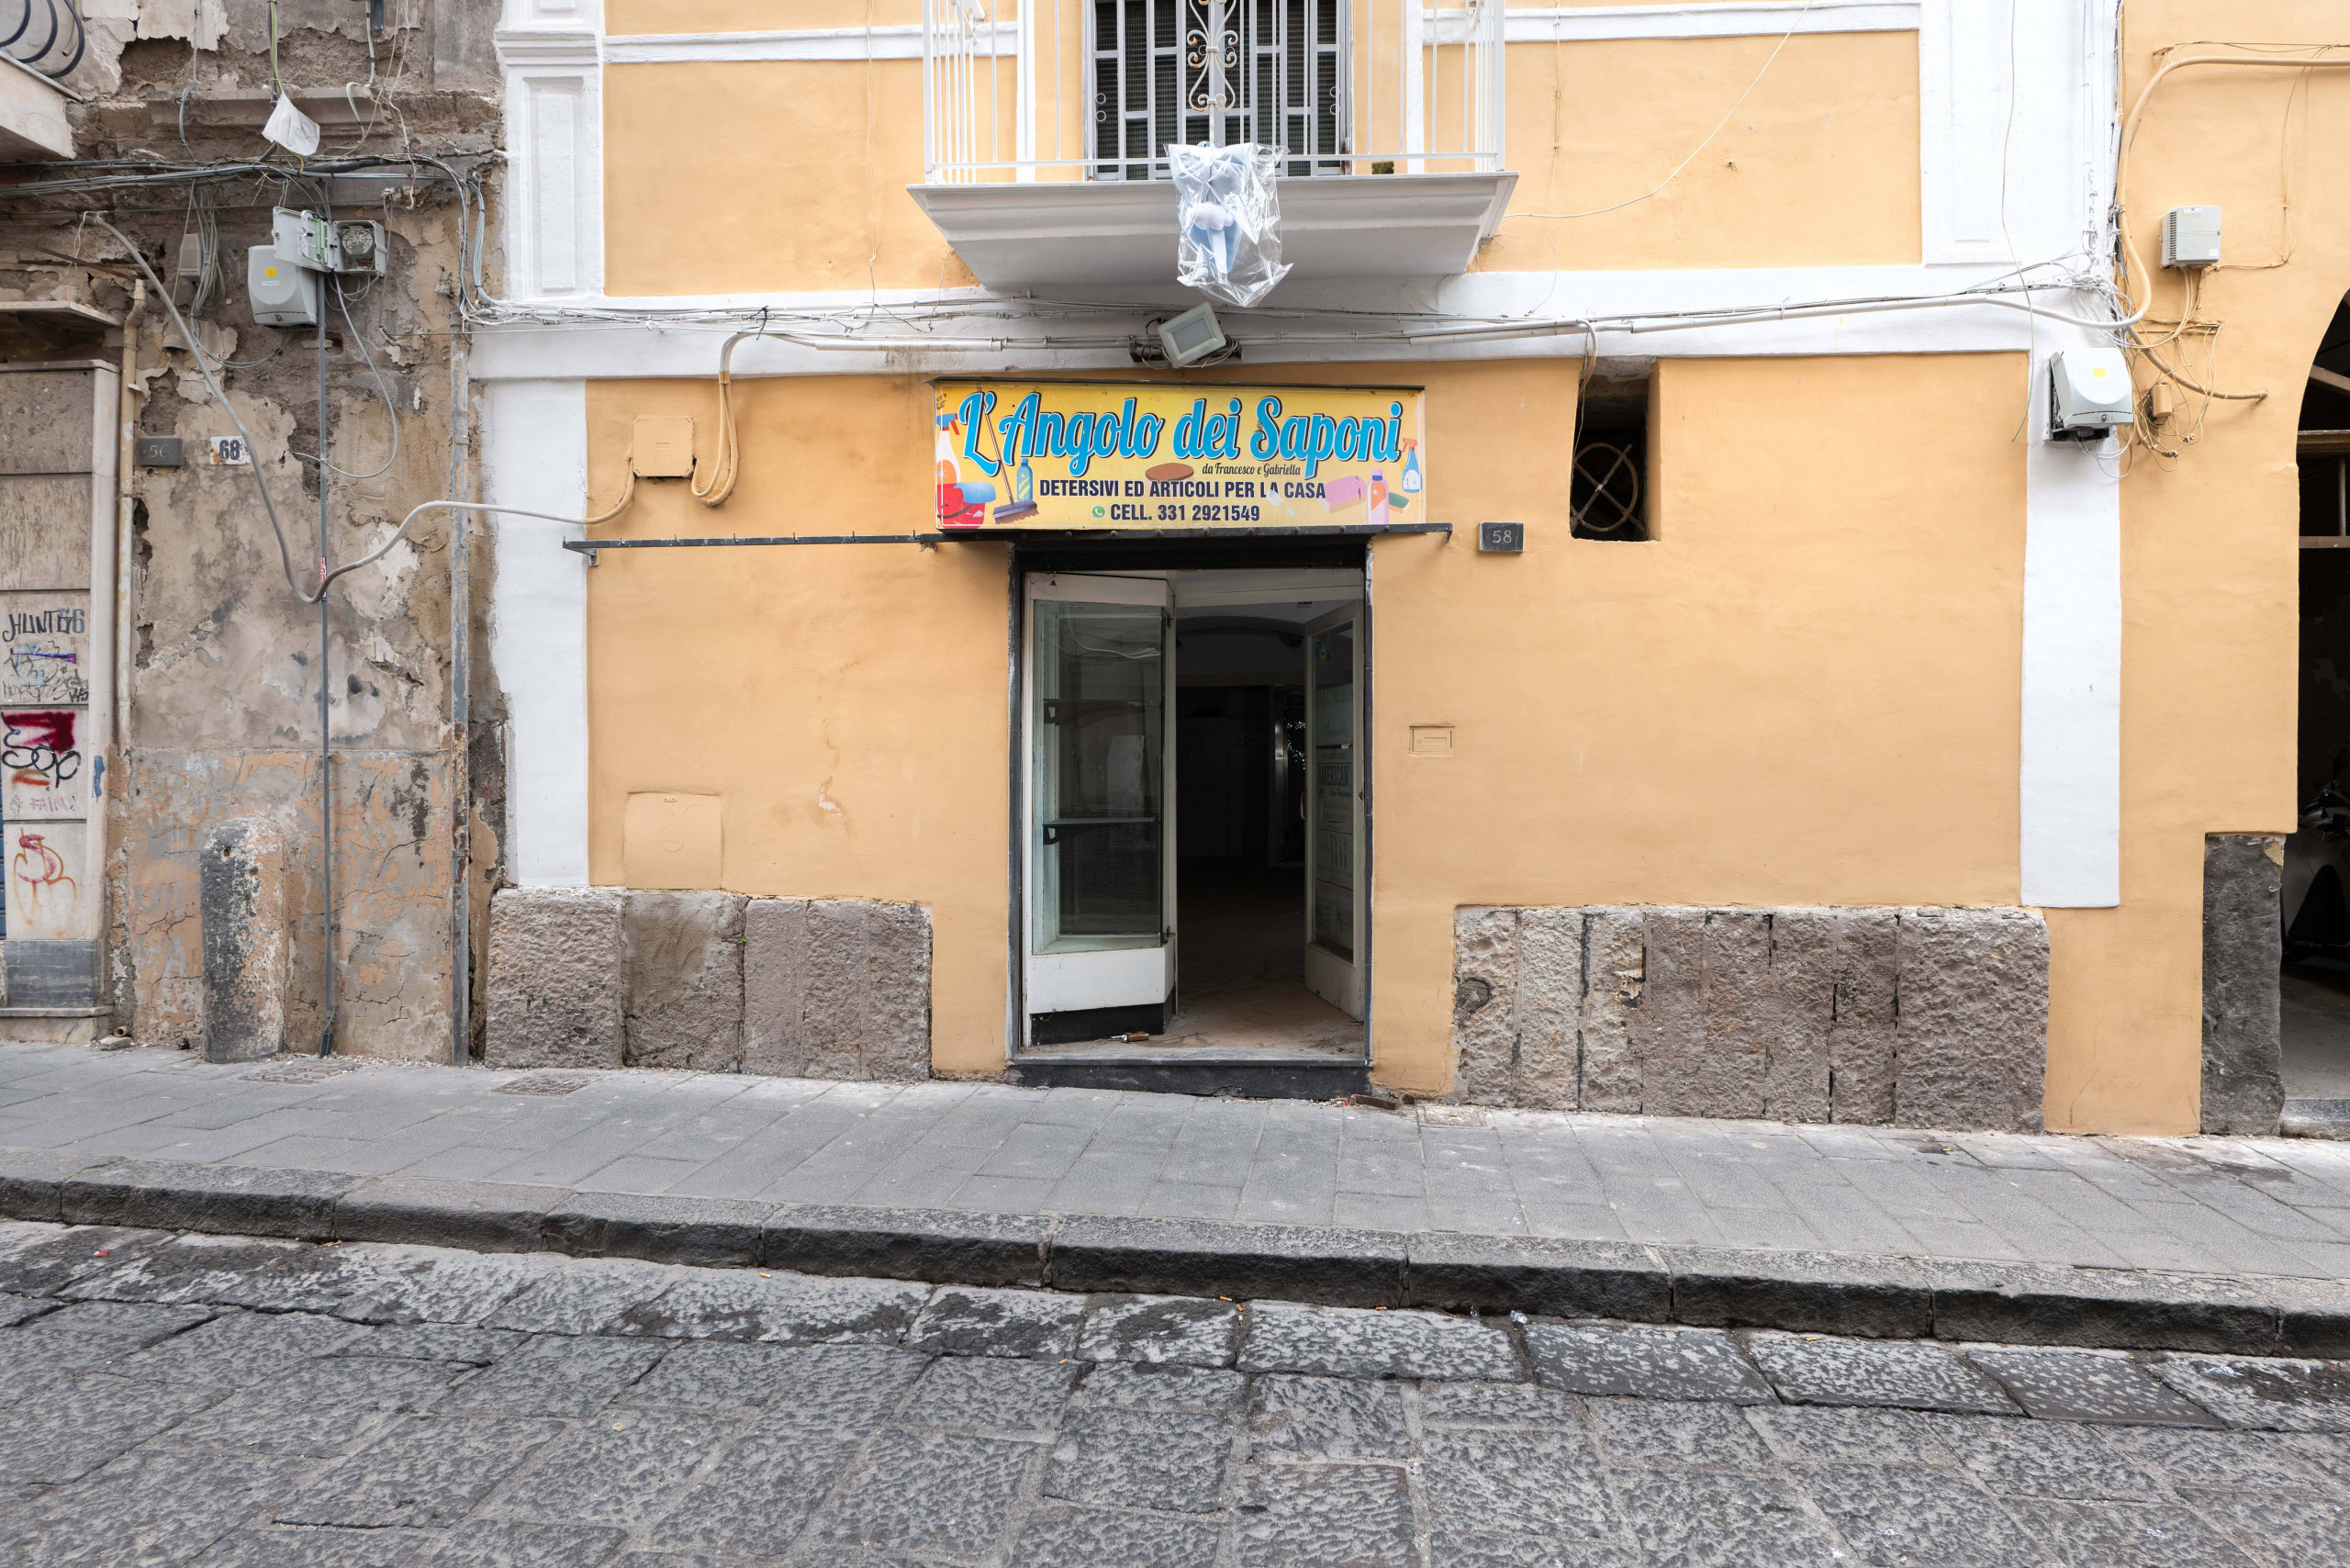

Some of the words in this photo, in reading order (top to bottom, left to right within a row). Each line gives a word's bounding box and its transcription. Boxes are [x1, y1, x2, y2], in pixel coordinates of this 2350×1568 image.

[957, 391, 1166, 477] L'Angolo
[1172, 398, 1243, 460] dei
[1249, 396, 1403, 481] Saponi
[219, 440, 241, 460] 68
[1202, 463, 1214, 475] da
[1214, 462, 1255, 476] Francesco
[1257, 465, 1262, 476] e
[1263, 463, 1301, 477] Gabriella
[1039, 479, 1119, 497] DETERSIVI
[1125, 480, 1145, 498] ED
[1149, 480, 1219, 498] ARTICOLI
[1225, 481, 1255, 498] PER
[1284, 481, 1326, 498] CASA
[1110, 504, 1153, 521] CELL.
[1158, 504, 1186, 521] 331
[1192, 504, 1260, 521] 2921549
[1492, 530, 1512, 543] 58
